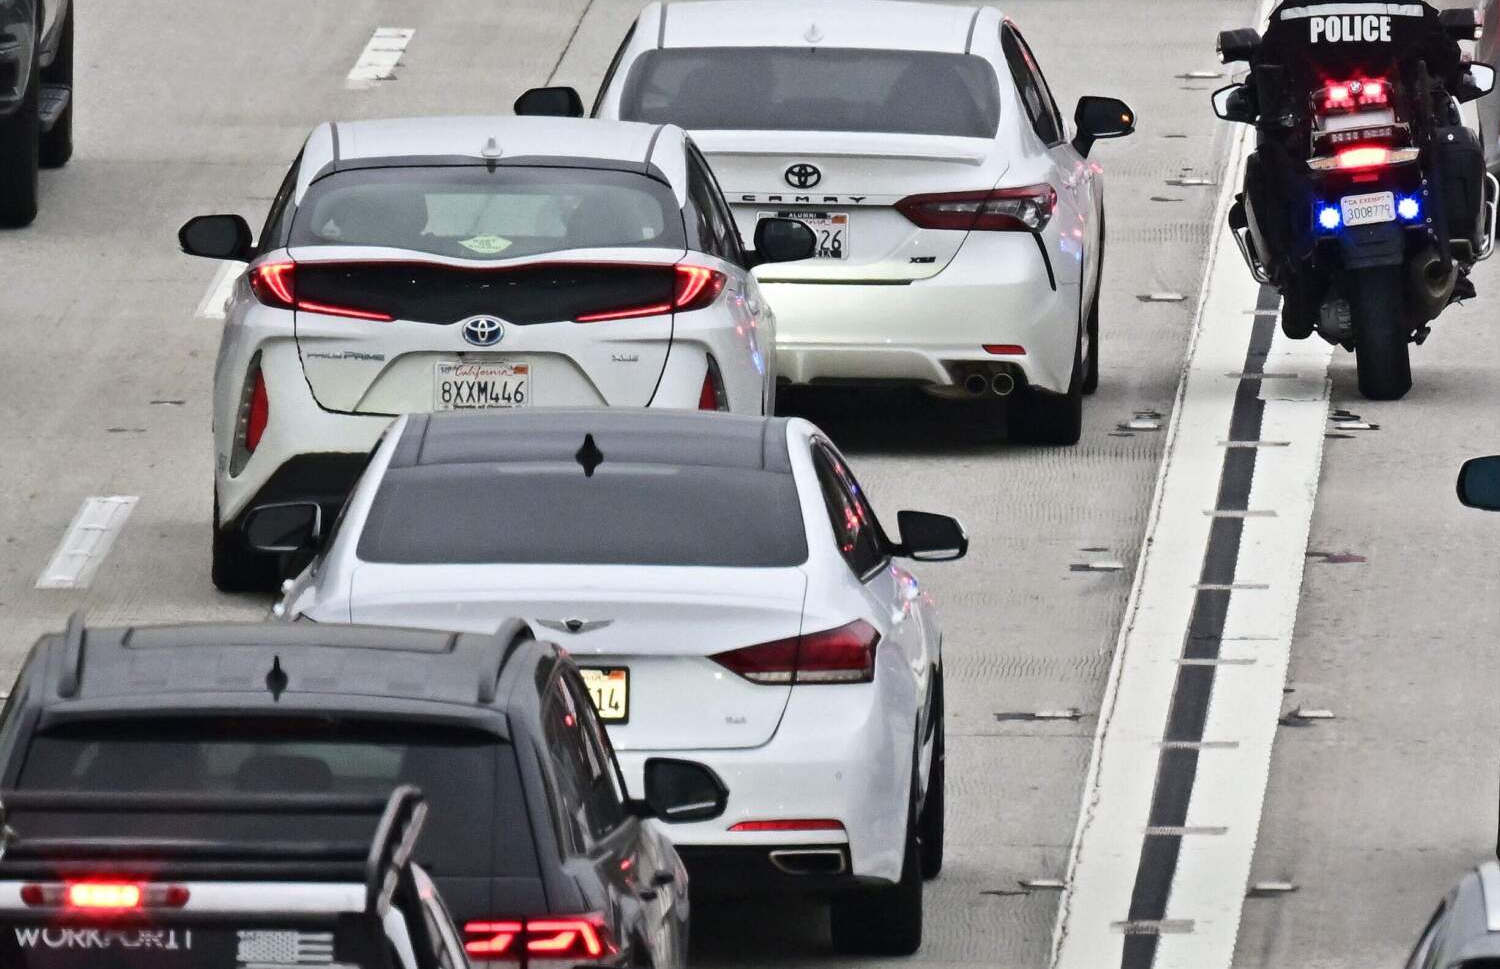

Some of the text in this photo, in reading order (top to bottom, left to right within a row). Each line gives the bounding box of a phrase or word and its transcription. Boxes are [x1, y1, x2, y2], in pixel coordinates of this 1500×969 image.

[1310, 15, 1392, 44] POLICE
[742, 194, 867, 203] CAMRY
[1358, 195, 1386, 205] EXEMPT
[1346, 204, 1392, 220] 3008779
[455, 364, 512, 380] California
[441, 381, 524, 403] 8XXM446
